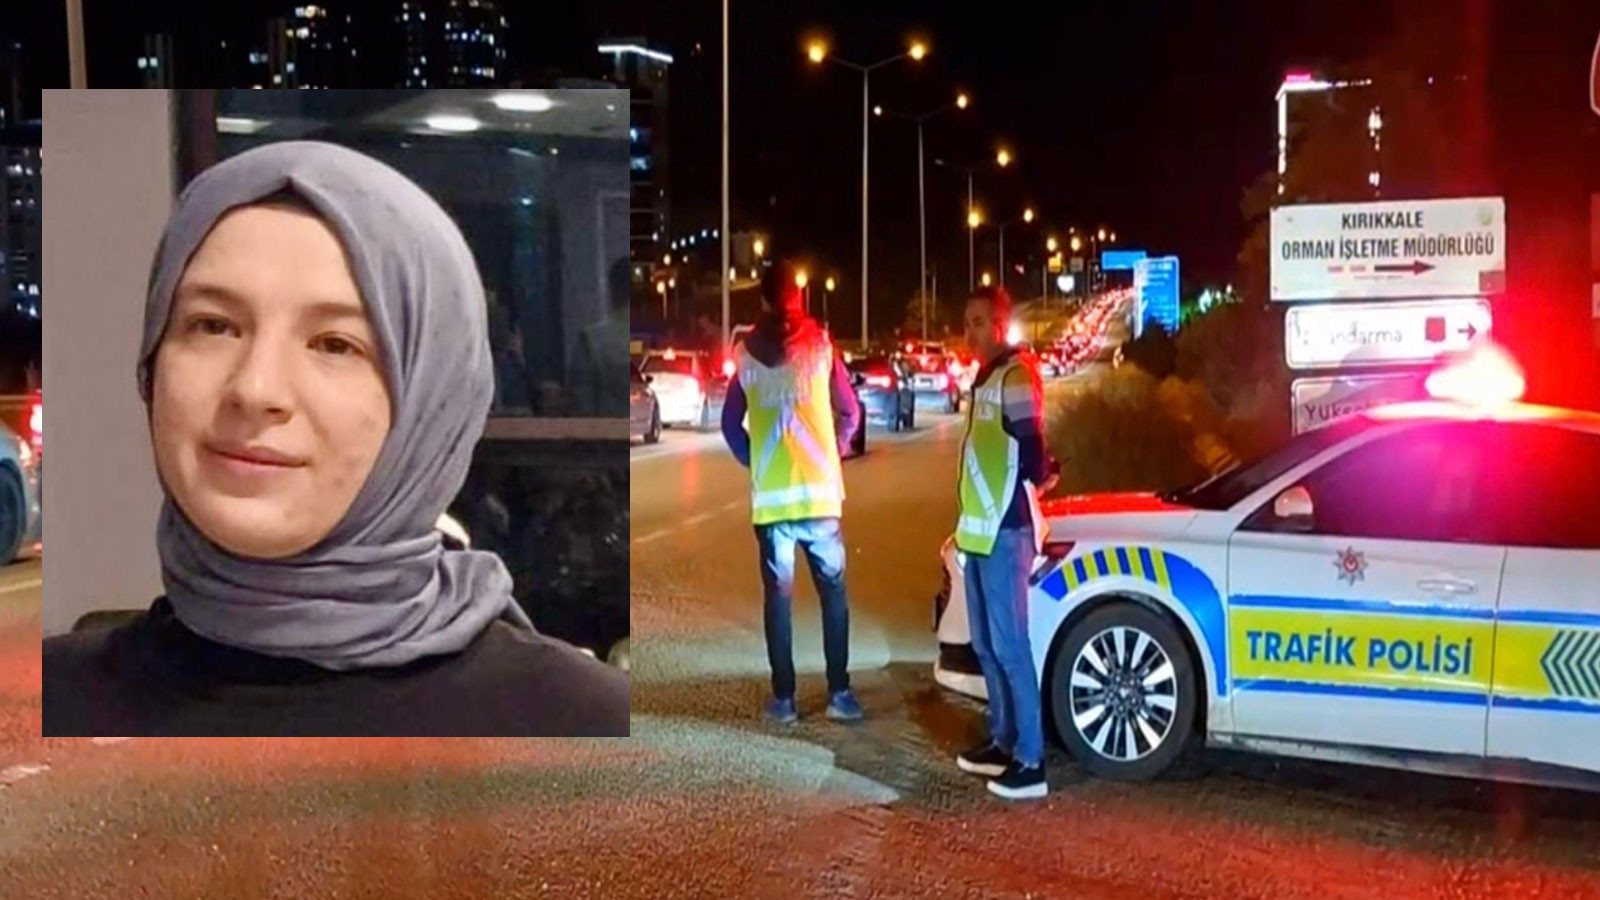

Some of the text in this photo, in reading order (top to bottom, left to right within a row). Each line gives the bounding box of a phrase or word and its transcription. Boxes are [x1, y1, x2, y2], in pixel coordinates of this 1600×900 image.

[1341, 211, 1424, 230] KIRIKKALE
[1281, 232, 1495, 261] ORMAN İŞLETME MÜDÜRLÜĞÜ
[1246, 628, 1473, 676] TRAFİK POLİSİ
